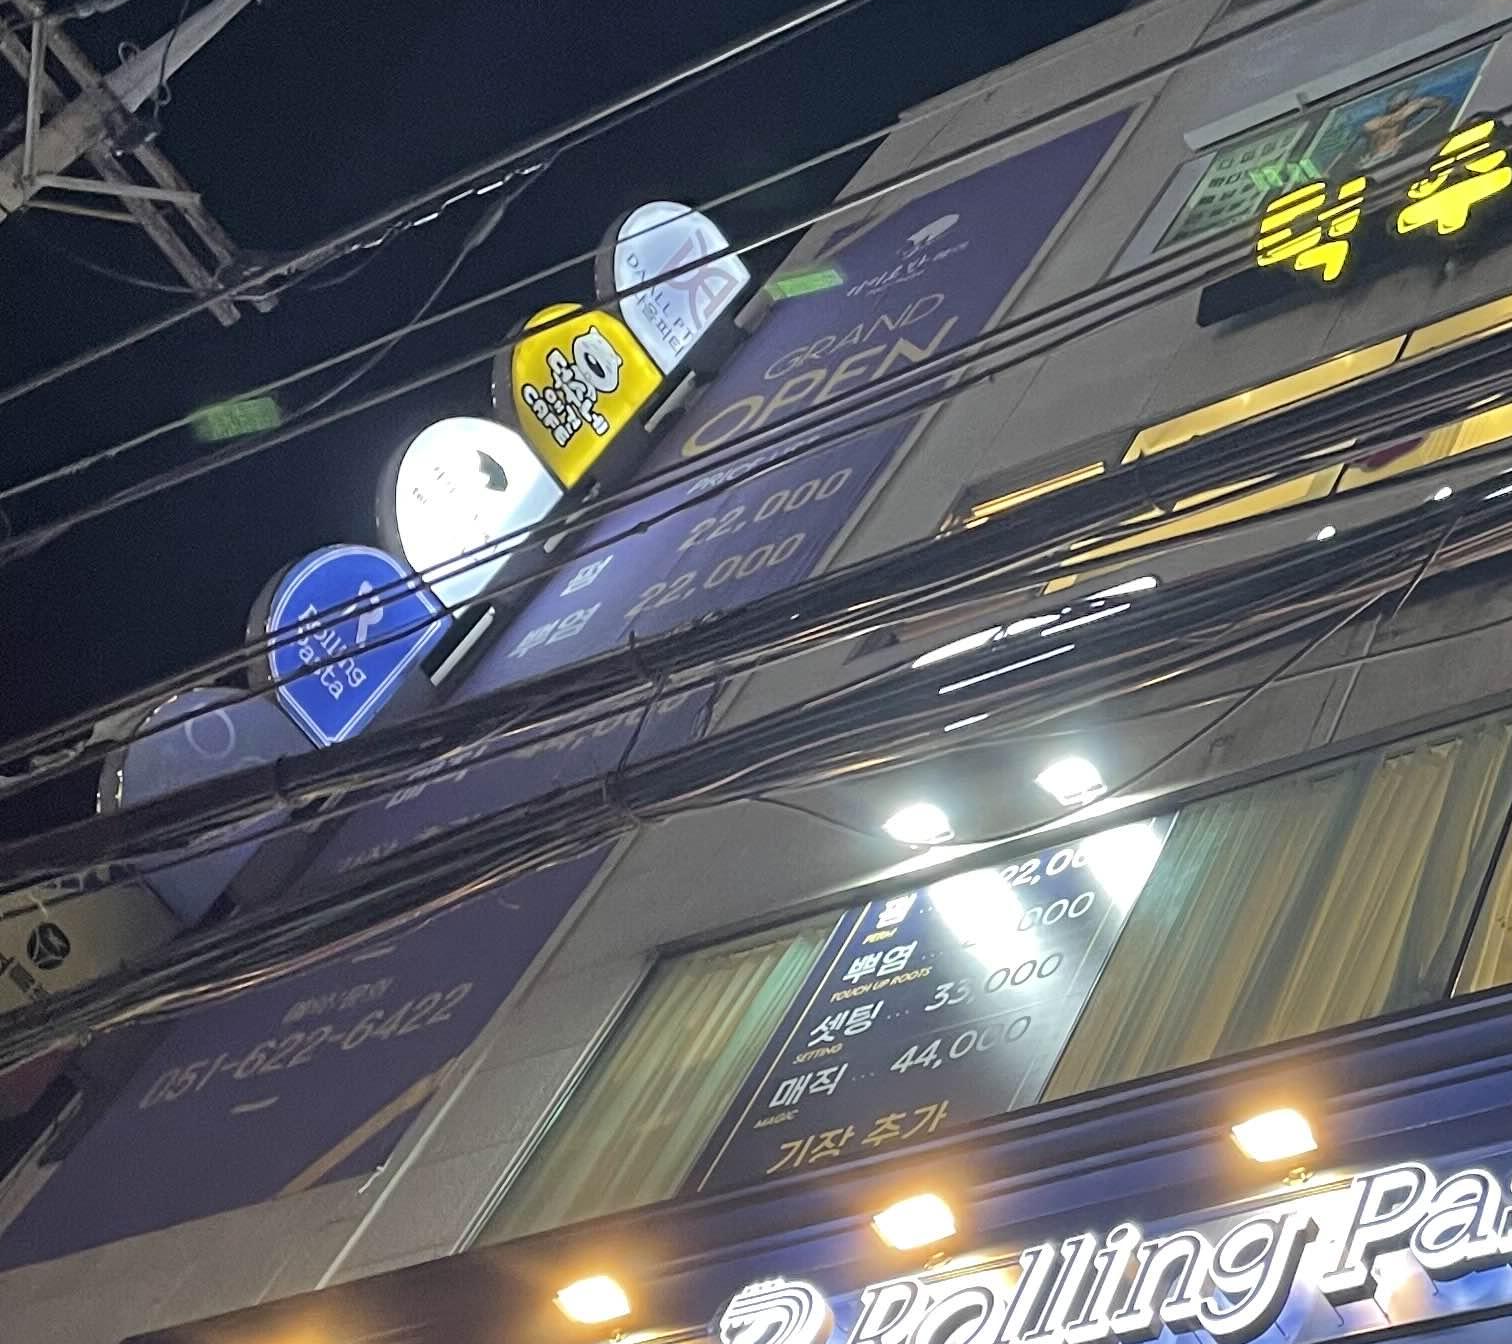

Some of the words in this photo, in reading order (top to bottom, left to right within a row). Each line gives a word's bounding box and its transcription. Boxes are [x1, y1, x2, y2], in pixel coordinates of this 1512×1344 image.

[764, 293, 945, 380] GRAND
[521, 383, 572, 448] CAFE
[681, 315, 960, 457] OPEN
[677, 467, 854, 554] 22,000
[624, 532, 806, 619] 22,000
[830, 982, 873, 1004] TOUCH
[892, 965, 933, 988] ROOTS
[843, 940, 918, 984] 뿌염
[139, 981, 474, 1109] 051-622-6422
[792, 1042, 843, 1066] SETTING
[807, 999, 885, 1048] 셋팅
[768, 1062, 849, 1109] 매직
[889, 1015, 1032, 1073] 44,000
[753, 1109, 800, 1130] MAGIC
[861, 1099, 950, 1147] 추가
